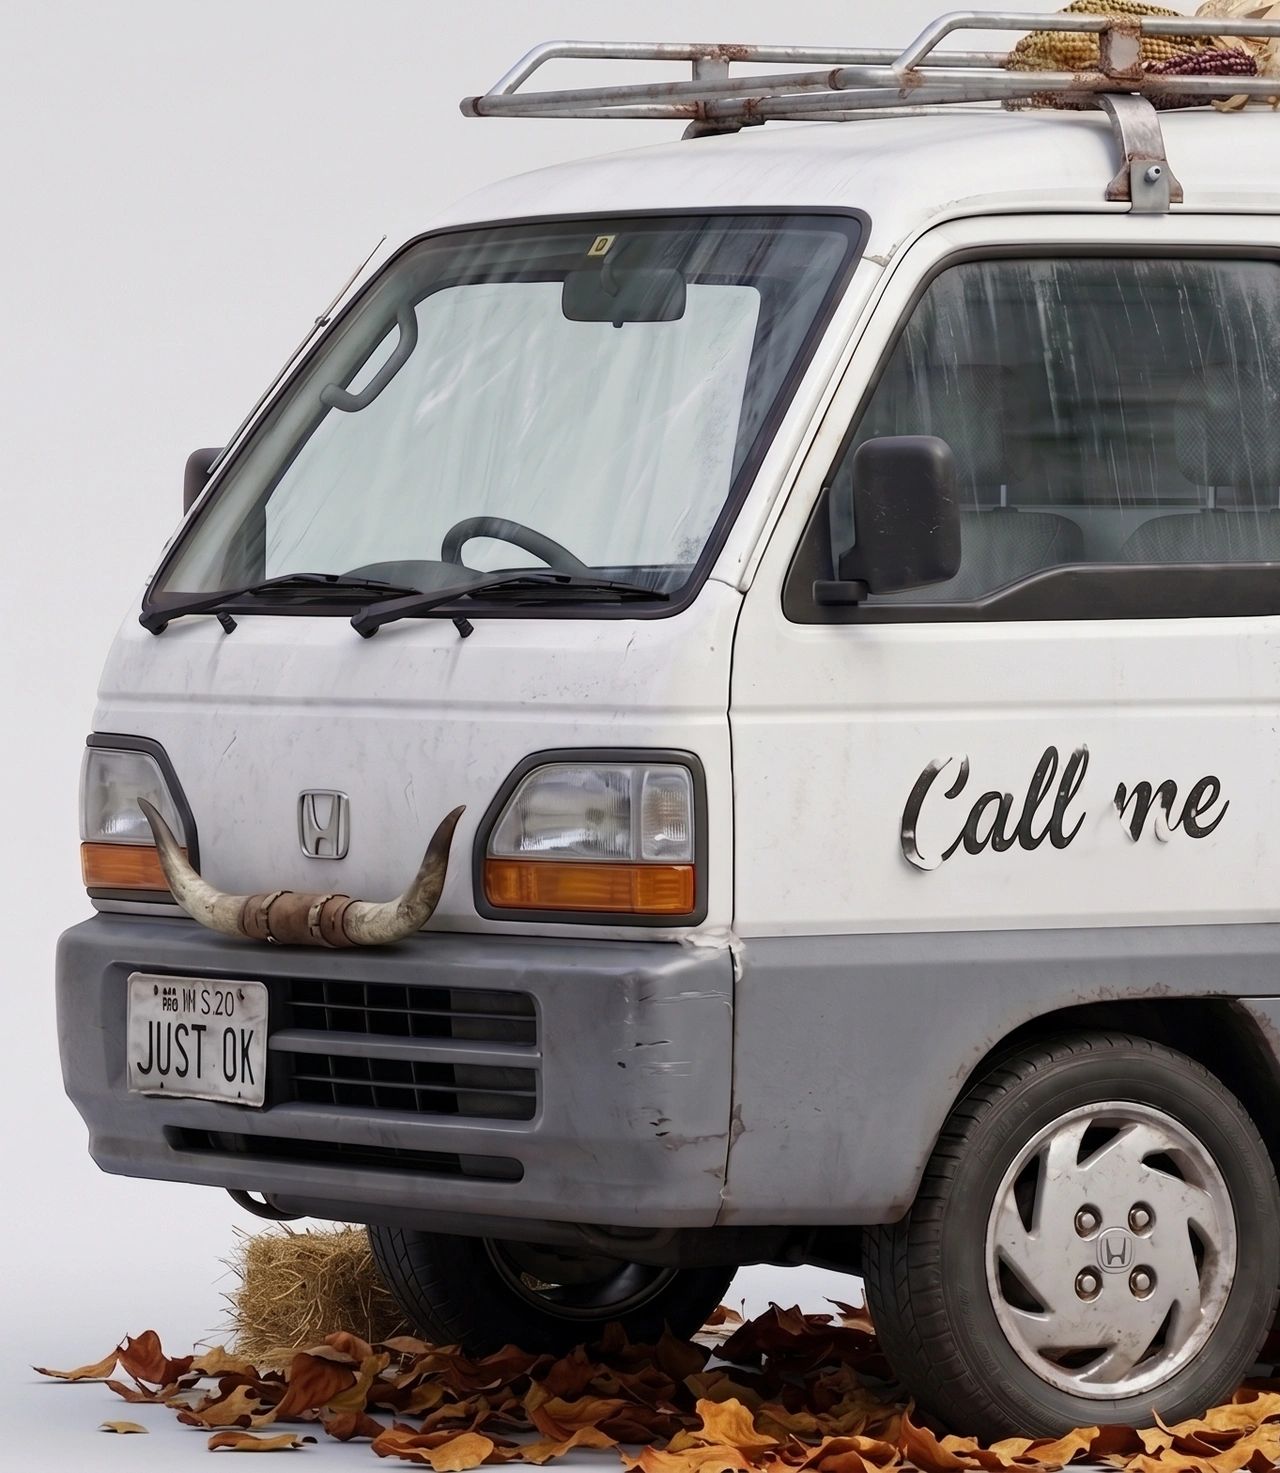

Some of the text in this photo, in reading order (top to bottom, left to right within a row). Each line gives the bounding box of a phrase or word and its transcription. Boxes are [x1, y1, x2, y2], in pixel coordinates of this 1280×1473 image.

[899, 745, 1231, 872] Call me
[137, 1020, 255, 1085] JUST OK
